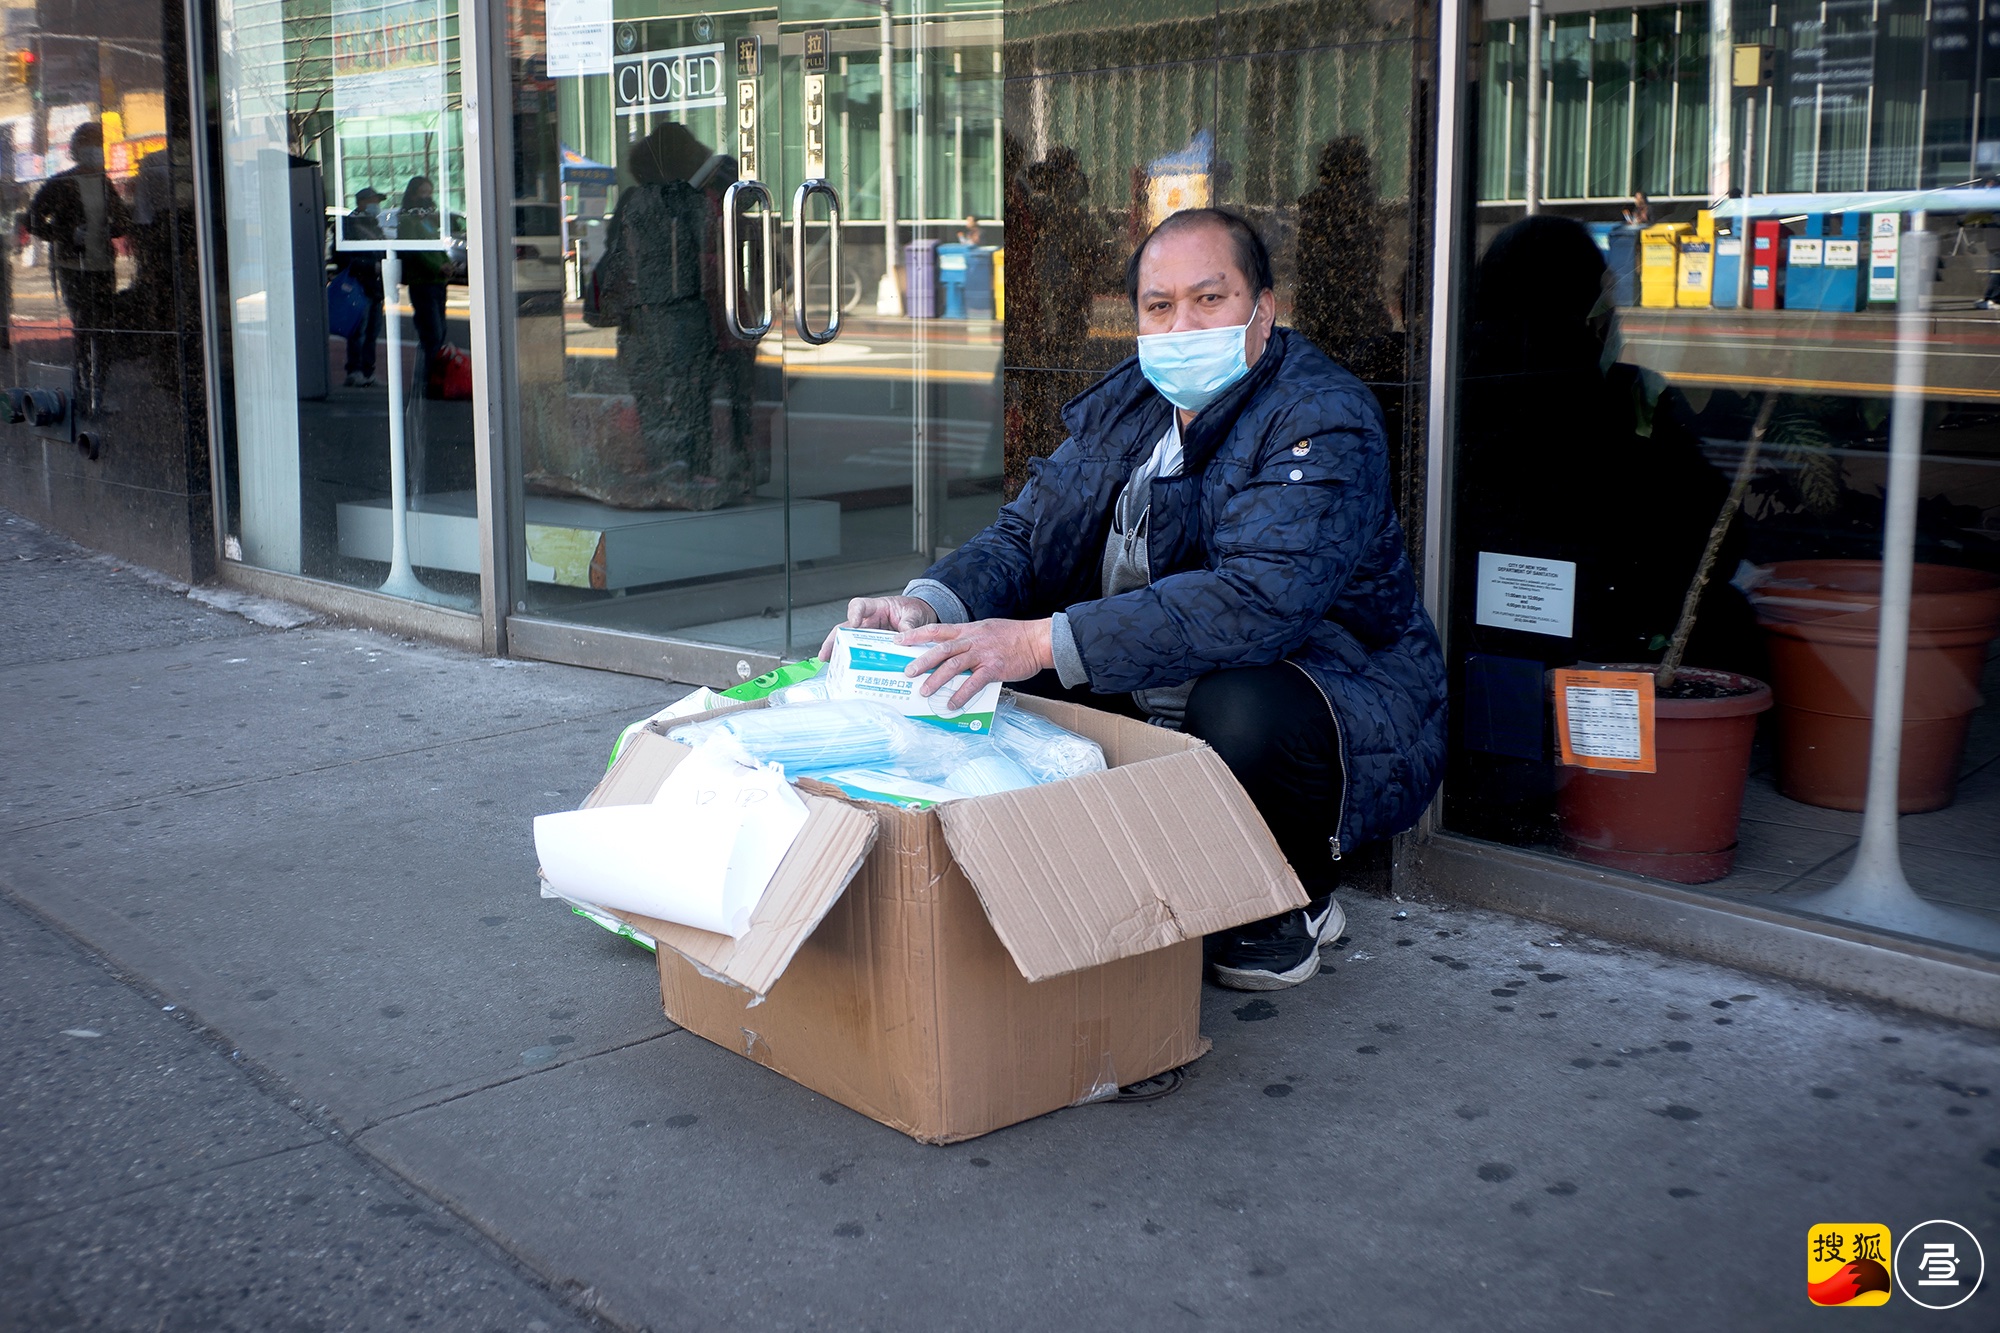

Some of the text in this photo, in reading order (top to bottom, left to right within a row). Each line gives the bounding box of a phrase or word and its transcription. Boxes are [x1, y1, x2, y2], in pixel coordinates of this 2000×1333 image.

[739, 40, 754, 60] 拉
[807, 34, 822, 55] 拉
[618, 56, 722, 104] CLOSED
[740, 84, 754, 176] PULL
[856, 675, 913, 688] 舒适型防护口罩
